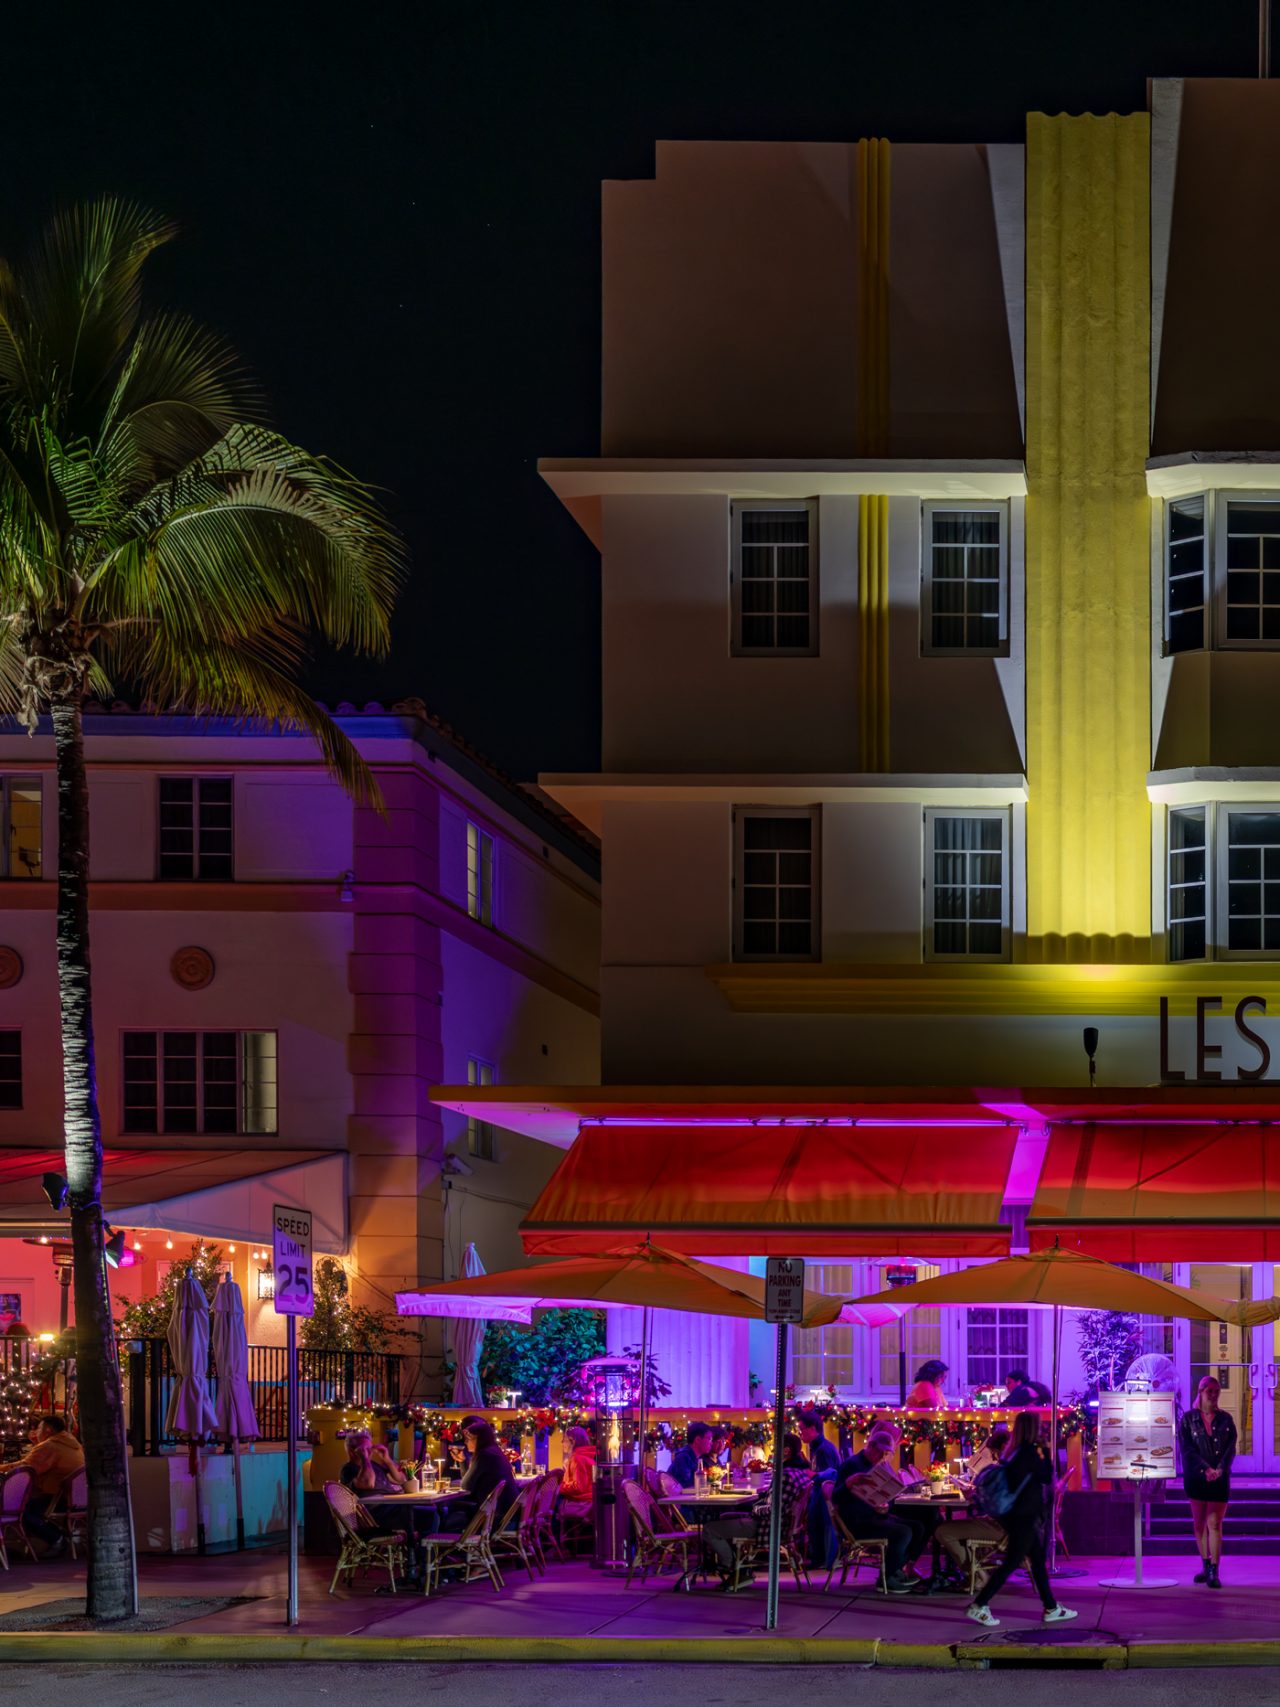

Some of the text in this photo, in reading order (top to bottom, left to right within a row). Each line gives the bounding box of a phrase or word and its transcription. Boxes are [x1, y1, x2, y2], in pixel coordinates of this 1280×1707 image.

[277, 1217, 309, 1236] SPEED
[280, 1241, 306, 1258] LIMIT
[778, 1261, 792, 1273] NO
[278, 1264, 309, 1304] 25
[769, 1275, 801, 1287] PARKING
